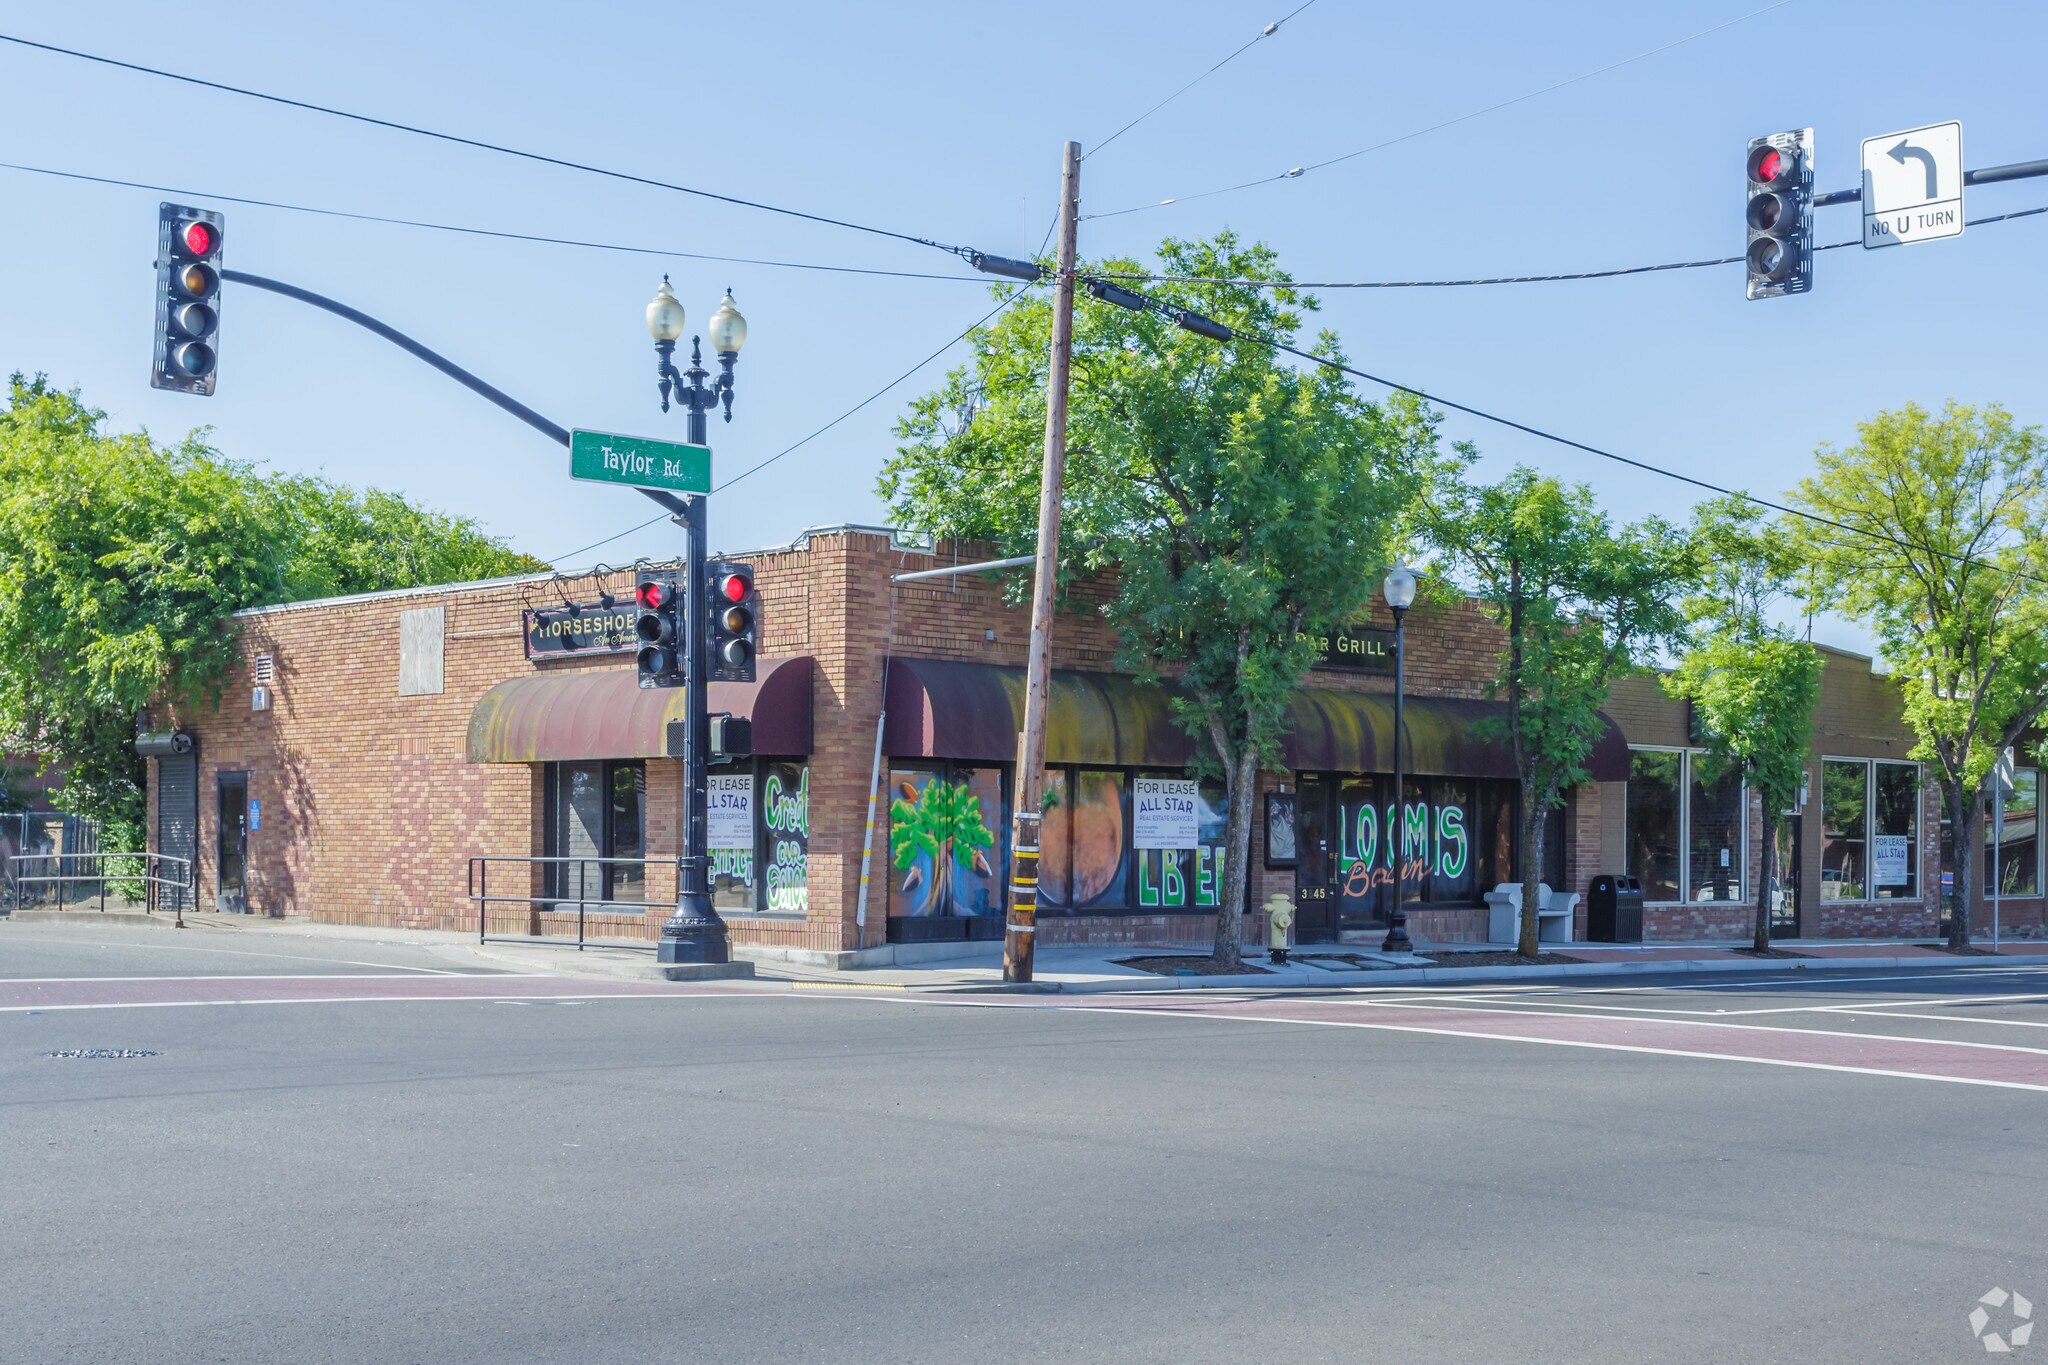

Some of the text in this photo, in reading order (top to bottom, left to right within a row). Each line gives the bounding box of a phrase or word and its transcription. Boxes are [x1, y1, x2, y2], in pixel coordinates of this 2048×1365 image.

[1872, 210, 1953, 236] NO U TURN
[601, 446, 654, 476] Taylor
[540, 614, 634, 638] HORSESHOE
[1337, 636, 1385, 656] GRILL
[707, 779, 750, 790] OR LEASE
[1137, 783, 1195, 795] FOR LEASE
[721, 794, 747, 811] STAR
[1140, 797, 1193, 814] ALL STAR
[1340, 802, 1468, 879] LOOMIS
[1889, 838, 1905, 846] LEASE
[1877, 849, 1905, 860] ALL STAR
